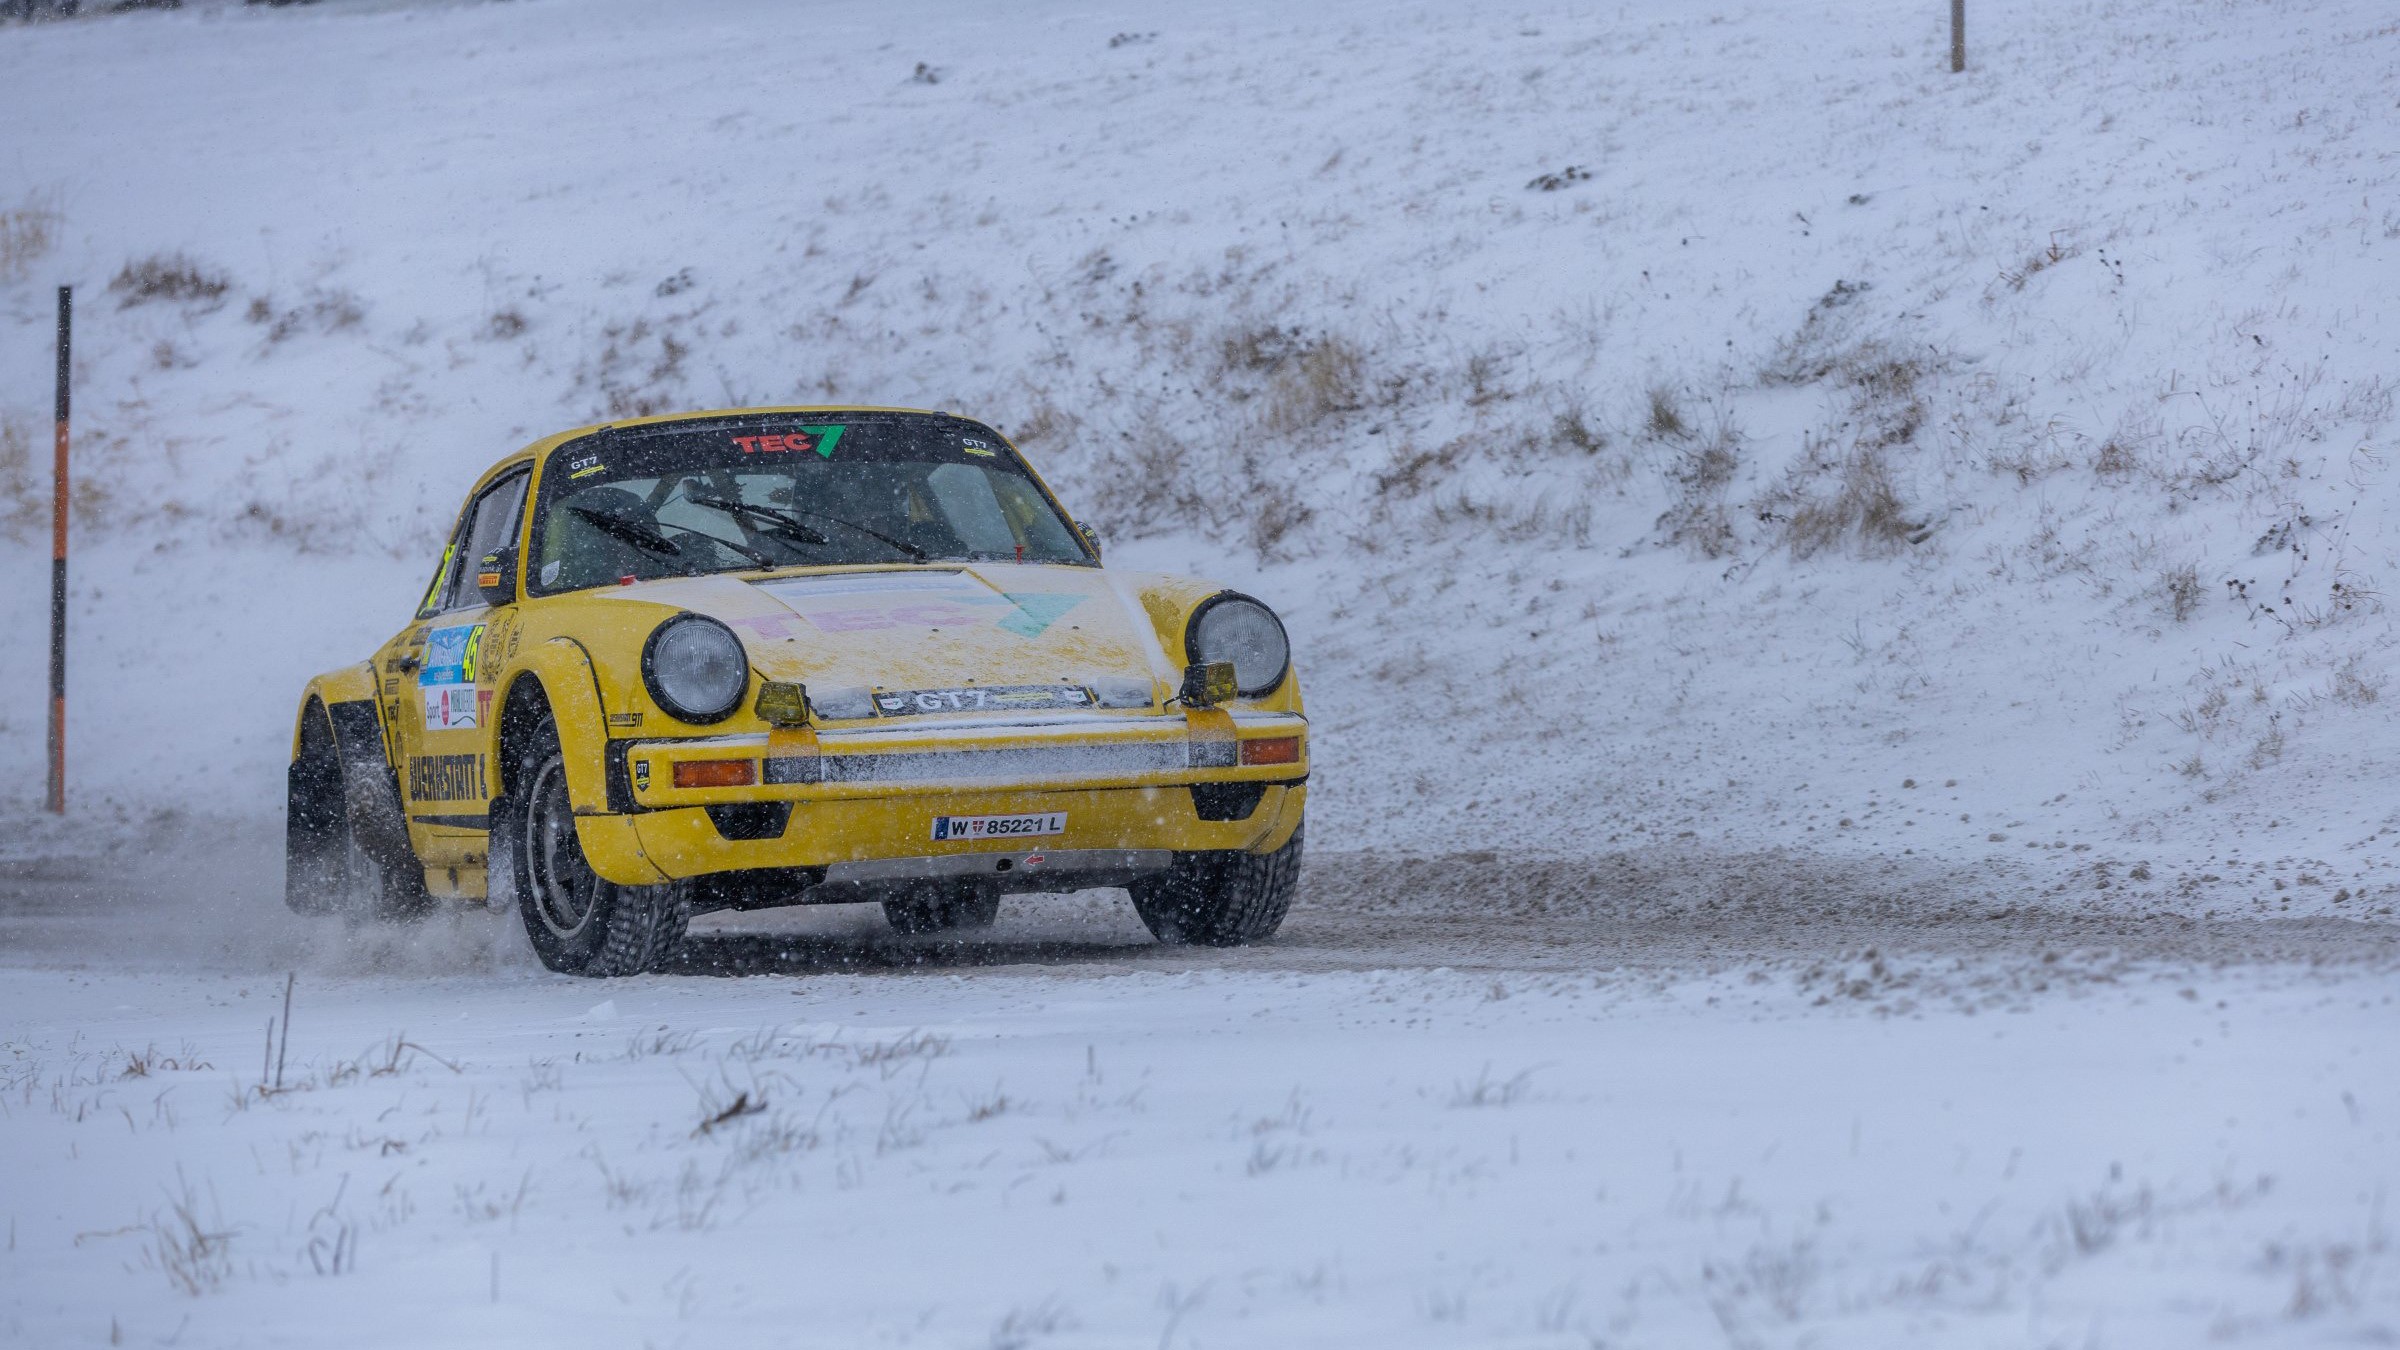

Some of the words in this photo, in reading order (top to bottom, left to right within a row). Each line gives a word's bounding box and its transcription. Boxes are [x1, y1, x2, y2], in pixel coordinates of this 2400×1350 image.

[732, 425, 846, 458] TEC7
[963, 438, 987, 449] GT7
[571, 456, 597, 470] GT7
[463, 626, 484, 682] 45
[915, 690, 985, 710] GT7
[427, 701, 440, 724] Sport
[410, 754, 476, 801] WERKSTATT
[637, 763, 648, 774] GT7
[952, 821, 968, 835] W
[987, 818, 1043, 835] 85221
[1050, 817, 1060, 831] L
